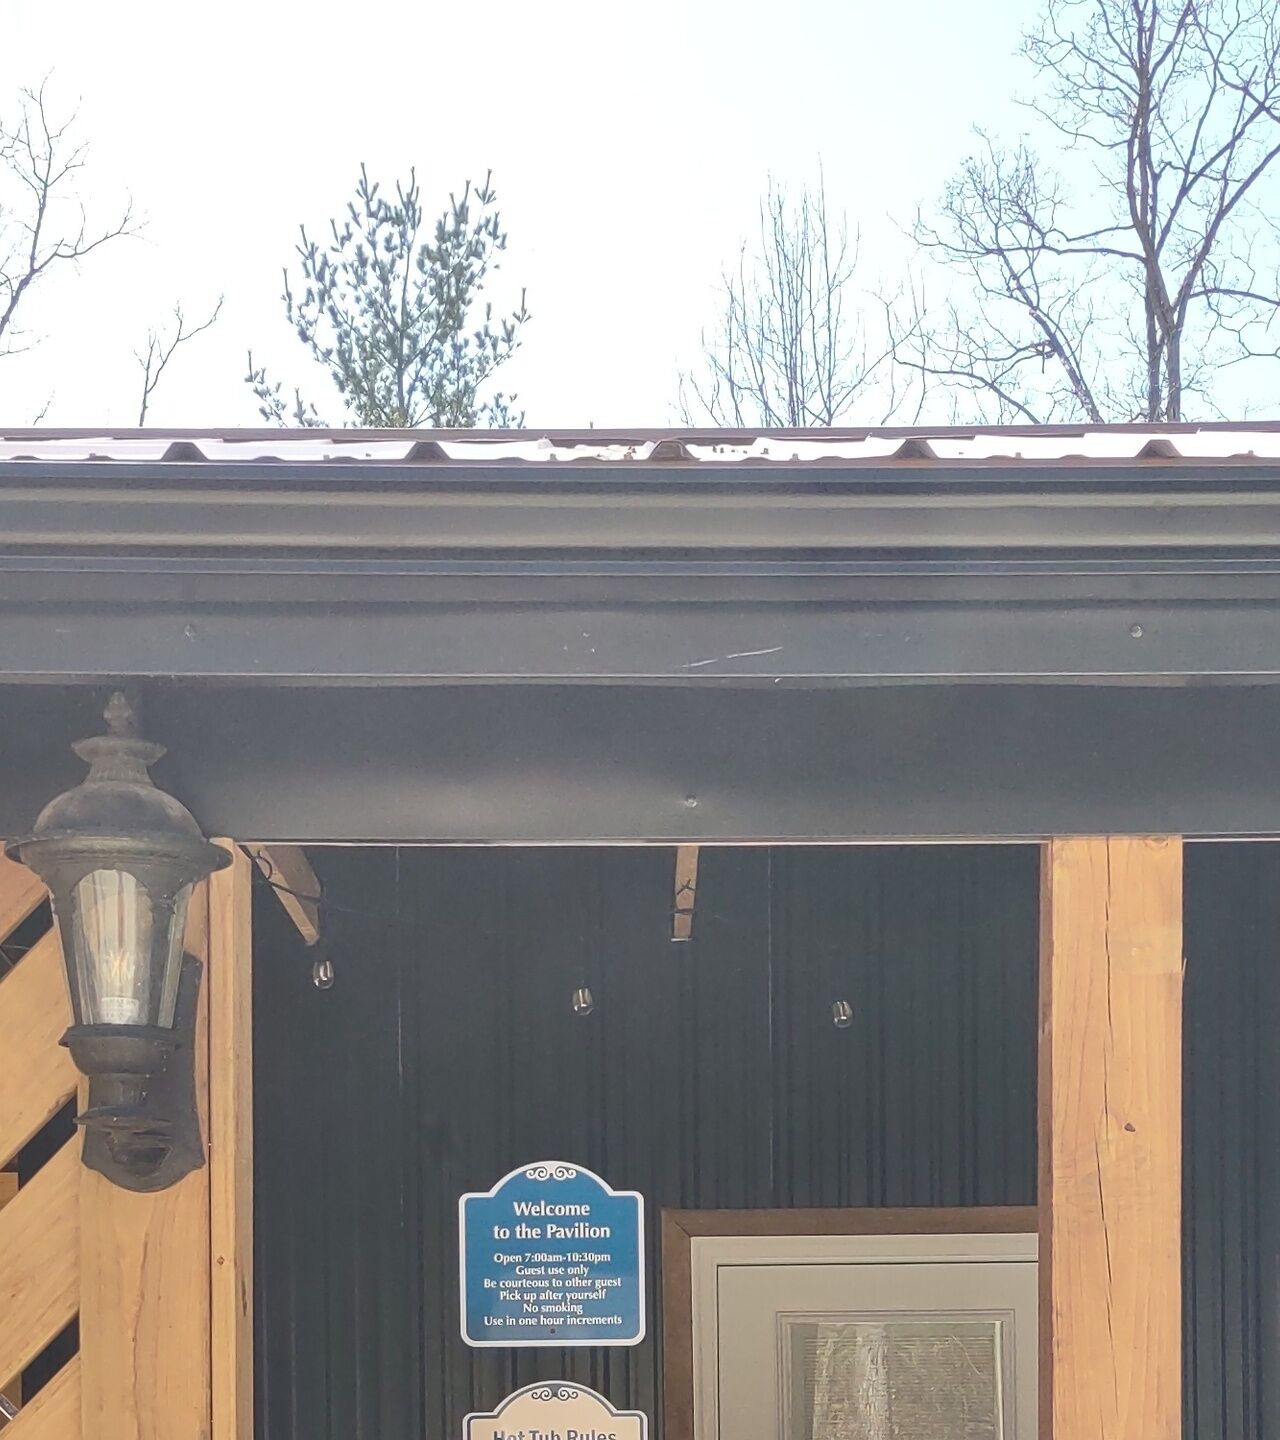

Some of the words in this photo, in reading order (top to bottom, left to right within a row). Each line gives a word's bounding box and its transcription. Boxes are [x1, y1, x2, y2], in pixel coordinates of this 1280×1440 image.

[513, 1200, 590, 1216] Welcome
[494, 1225, 510, 1239] to
[515, 1223, 541, 1239] the
[547, 1222, 610, 1238] Pavilion
[494, 1253, 522, 1265] Open
[525, 1252, 611, 1264] 7:00am-10:30pm
[516, 1265, 545, 1275] Guest
[548, 1267, 565, 1275] use
[568, 1264, 589, 1276] only
[484, 1279, 497, 1288] Be
[500, 1279, 550, 1288] courteous
[552, 1279, 562, 1288] to
[565, 1278, 592, 1287] other
[595, 1278, 622, 1289] guest
[500, 1290, 521, 1300] Pick
[524, 1292, 536, 1302] up
[540, 1290, 562, 1300] after
[566, 1289, 607, 1302] yourself
[524, 1304, 538, 1313] No
[541, 1302, 583, 1314] smoking
[484, 1316, 503, 1326] Use
[506, 1315, 516, 1326] in
[519, 1318, 538, 1326] one
[540, 1315, 564, 1326] hour
[567, 1315, 622, 1325] increments
